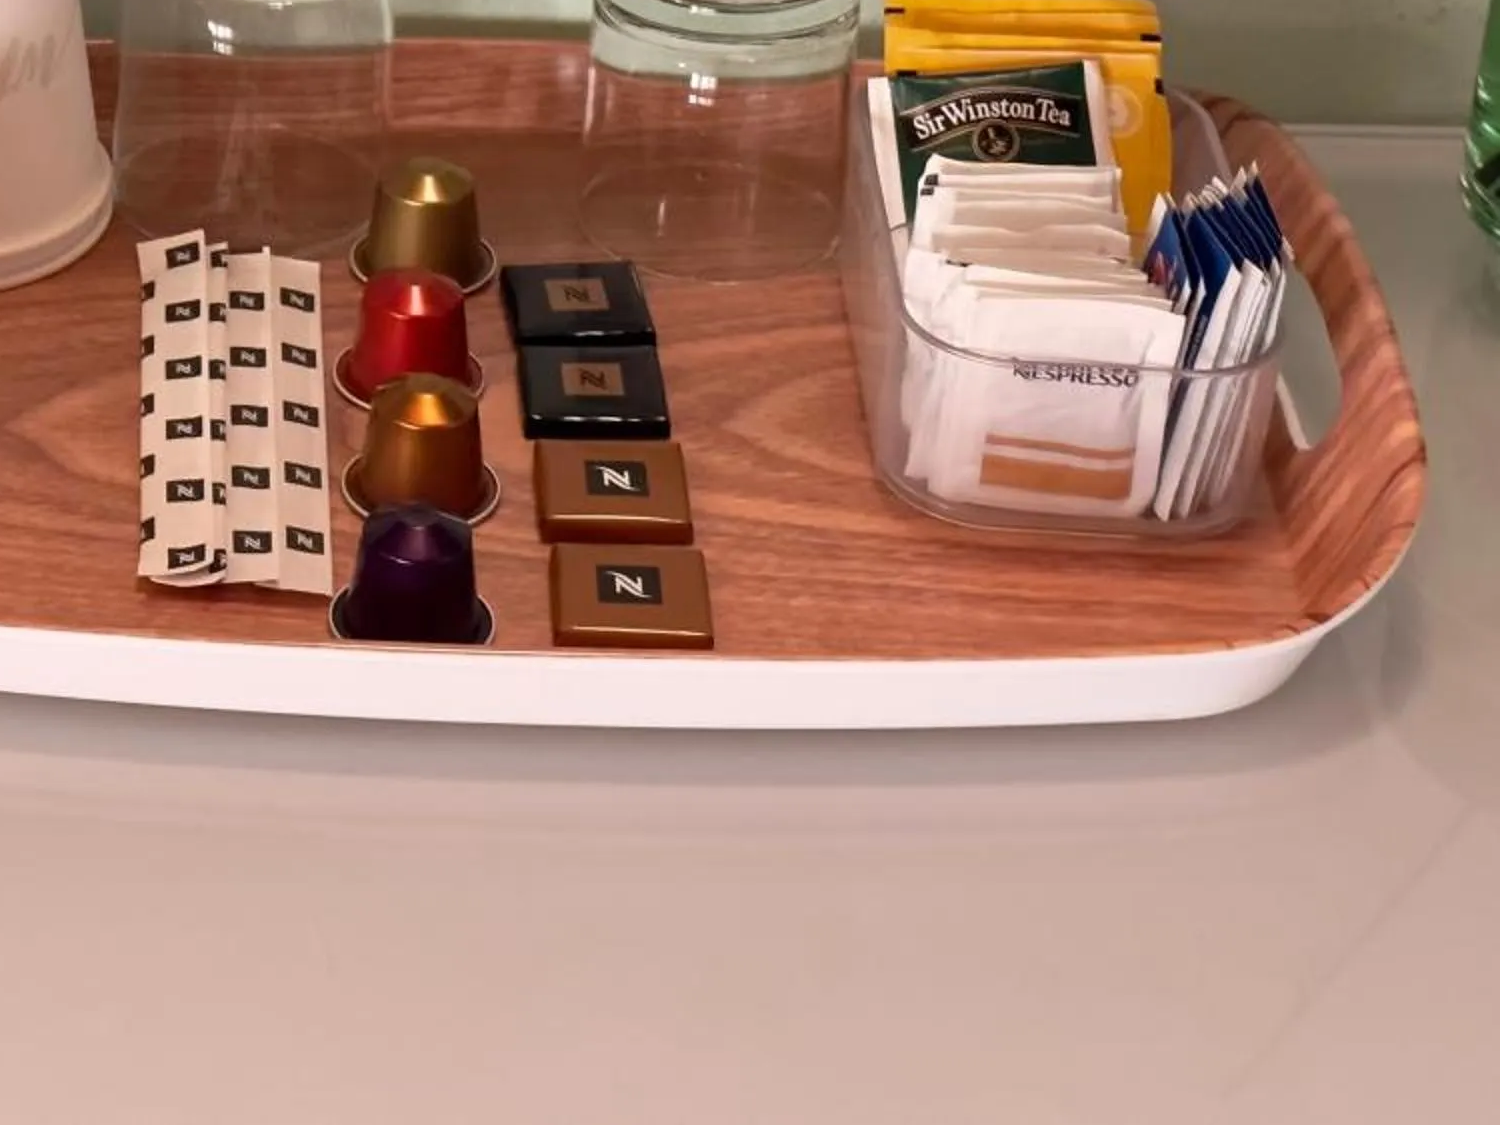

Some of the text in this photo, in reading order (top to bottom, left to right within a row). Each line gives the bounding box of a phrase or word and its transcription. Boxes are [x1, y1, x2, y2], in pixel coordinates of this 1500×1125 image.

[913, 98, 1072, 139] Sir Winston Tea
